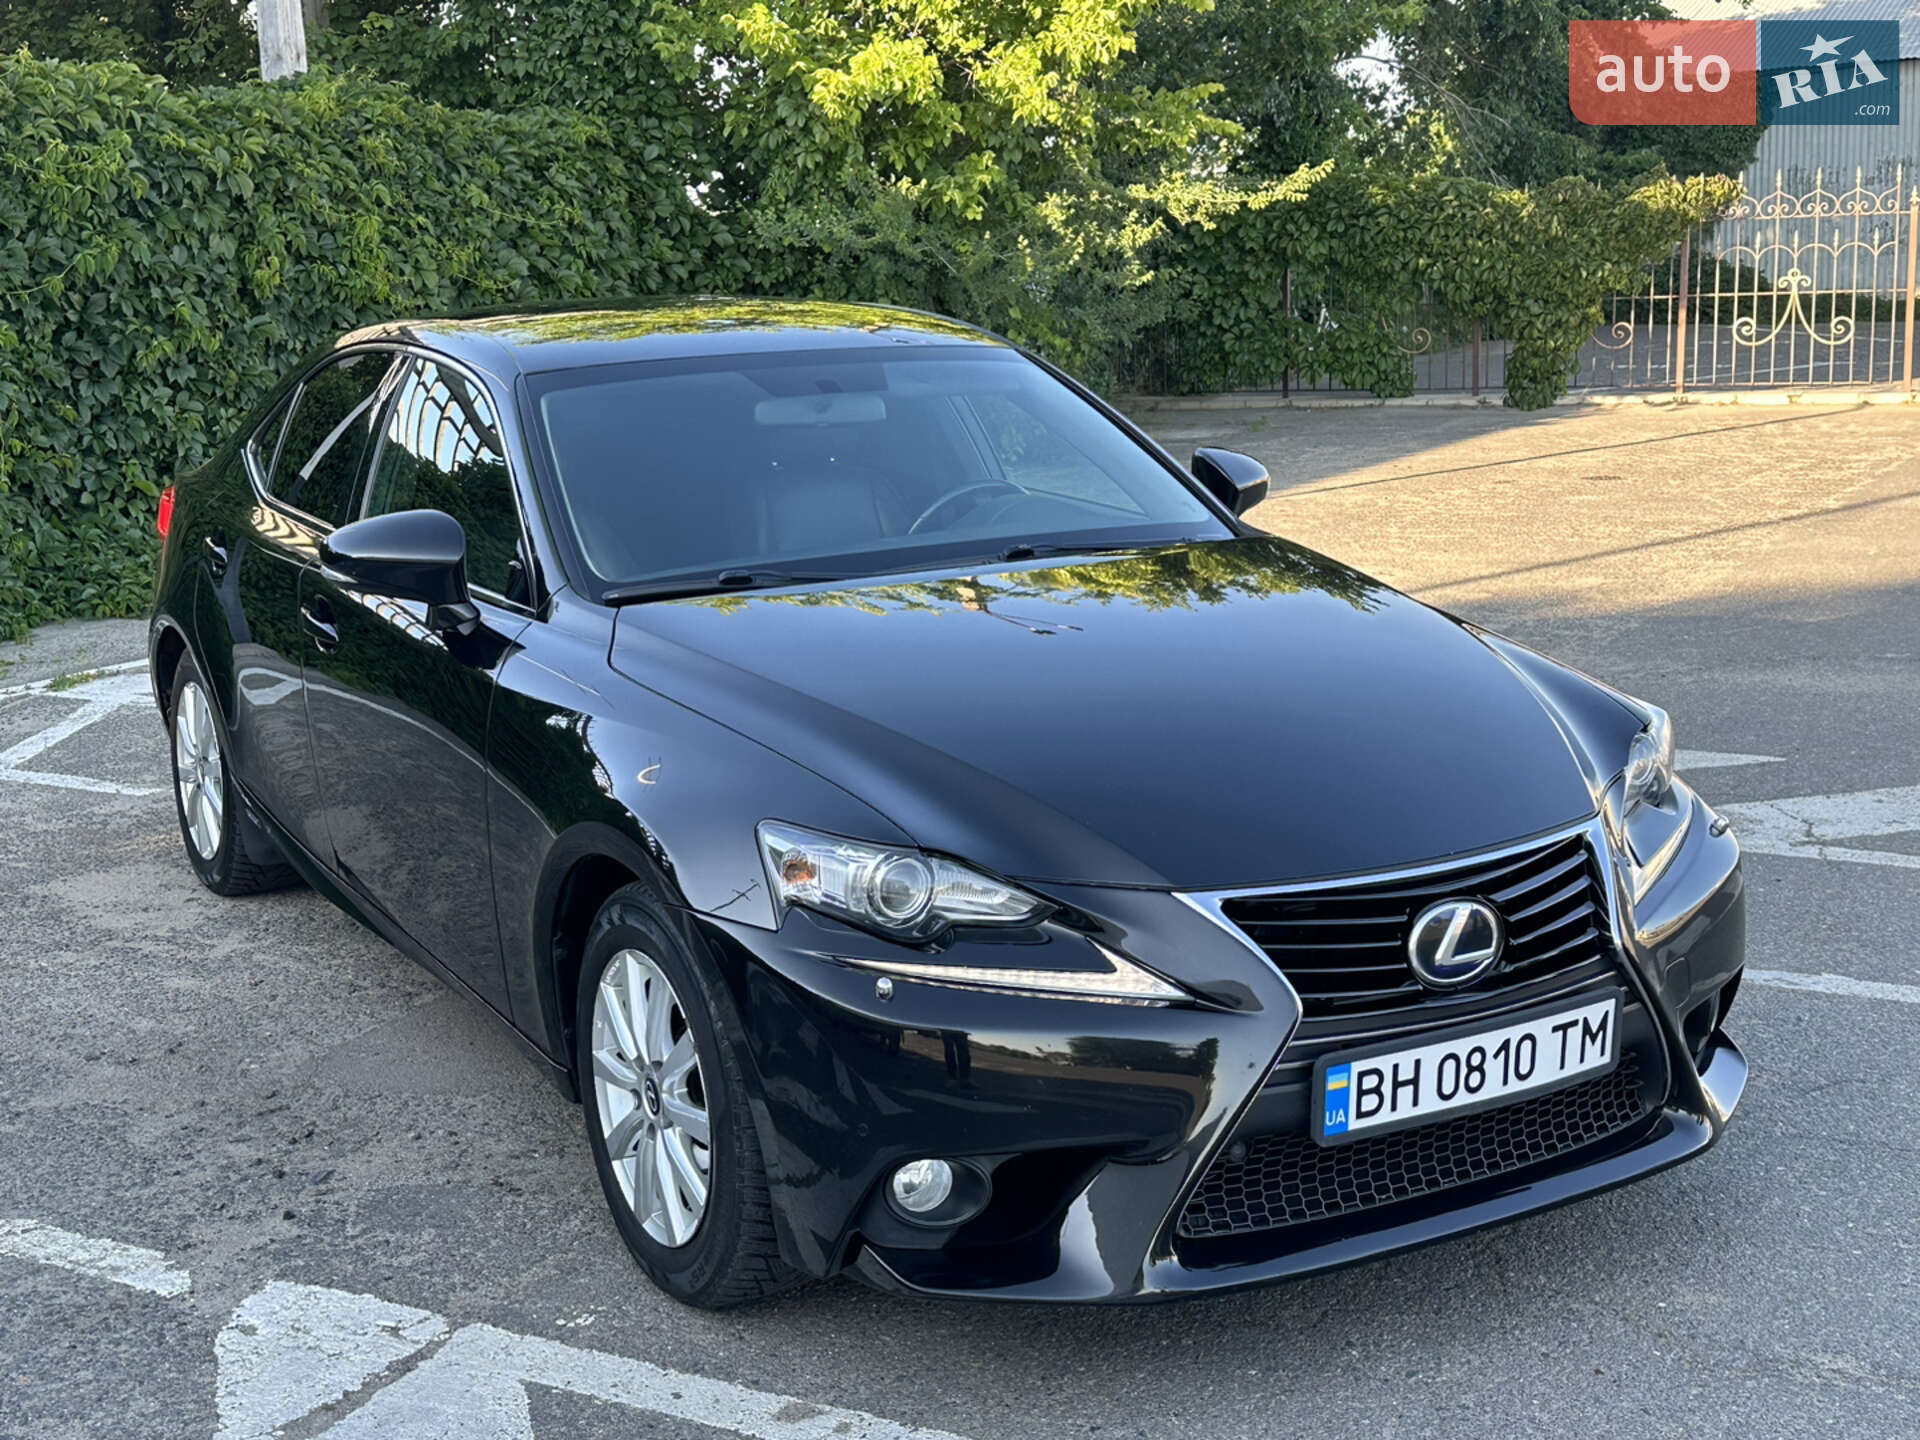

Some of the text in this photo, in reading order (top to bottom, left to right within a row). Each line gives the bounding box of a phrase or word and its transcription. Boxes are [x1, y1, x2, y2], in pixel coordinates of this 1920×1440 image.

[1354, 1009, 1611, 1121] BH 0810 TM
[1324, 1109, 1346, 1127] UA
